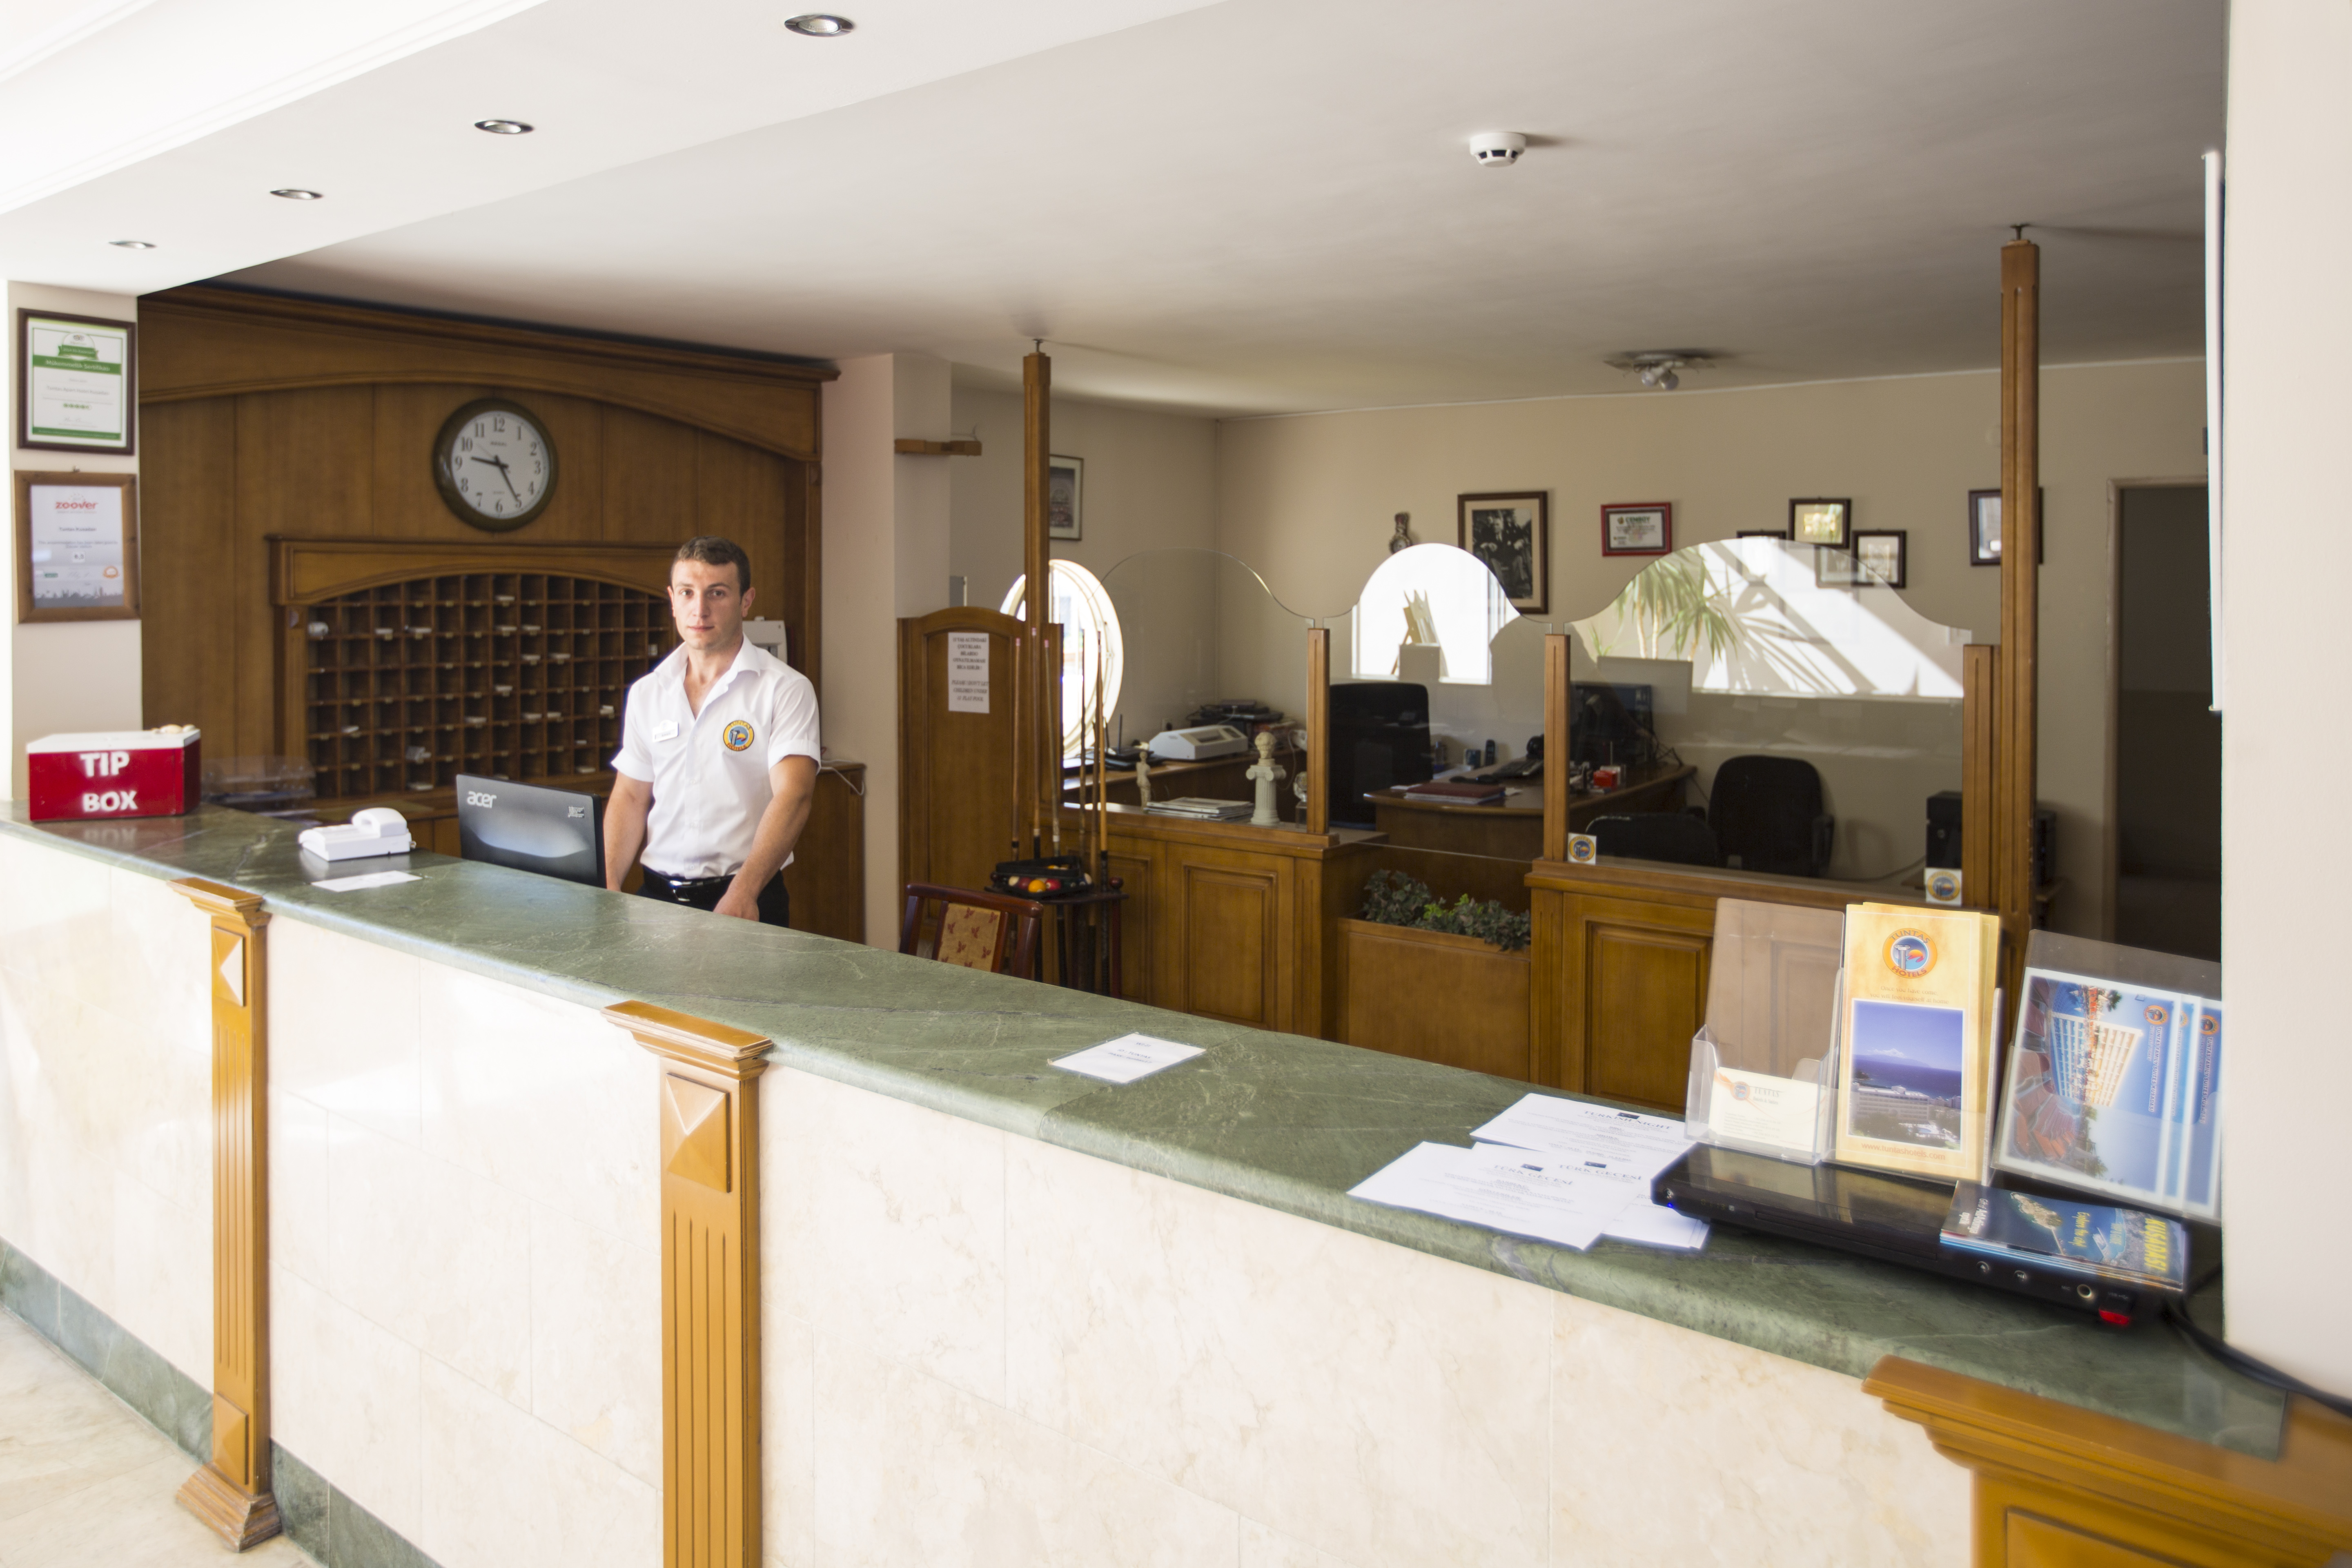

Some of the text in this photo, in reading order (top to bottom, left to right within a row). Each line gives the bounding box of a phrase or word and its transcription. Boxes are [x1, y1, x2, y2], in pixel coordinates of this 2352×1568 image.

[46, 359, 82, 368] Mükemmellik
[474, 423, 485, 437] 11
[494, 417, 505, 432] 12
[516, 426, 522, 440] 1
[462, 437, 473, 452] 10
[530, 442, 537, 456] 2
[454, 456, 462, 470] 9
[534, 461, 541, 475] 3
[461, 479, 469, 493] 8
[528, 481, 534, 495] 4
[55, 501, 98, 509] zoover
[476, 493, 483, 508] 7
[495, 499, 503, 513] 6
[80, 751, 130, 777] TIP
[83, 791, 138, 813] BOX
[467, 791, 497, 808] acer
[1889, 930, 1931, 944] TUNTAS
[1891, 965, 1927, 977] HOTELS
[1584, 1110, 1673, 1130] TURKISH NIGHT
[1861, 1143, 1945, 1160] www.tuntashotels.com
[1493, 1164, 1573, 1185] TÜRK GECESİ
[1559, 1164, 1642, 1181] TÜRK GECESİ
[1959, 1212, 1970, 1225] optik
[2072, 1212, 2090, 1228] Explore
[2068, 1236, 2087, 1247] city!
[2139, 1218, 2166, 1272] KUŞADASI
